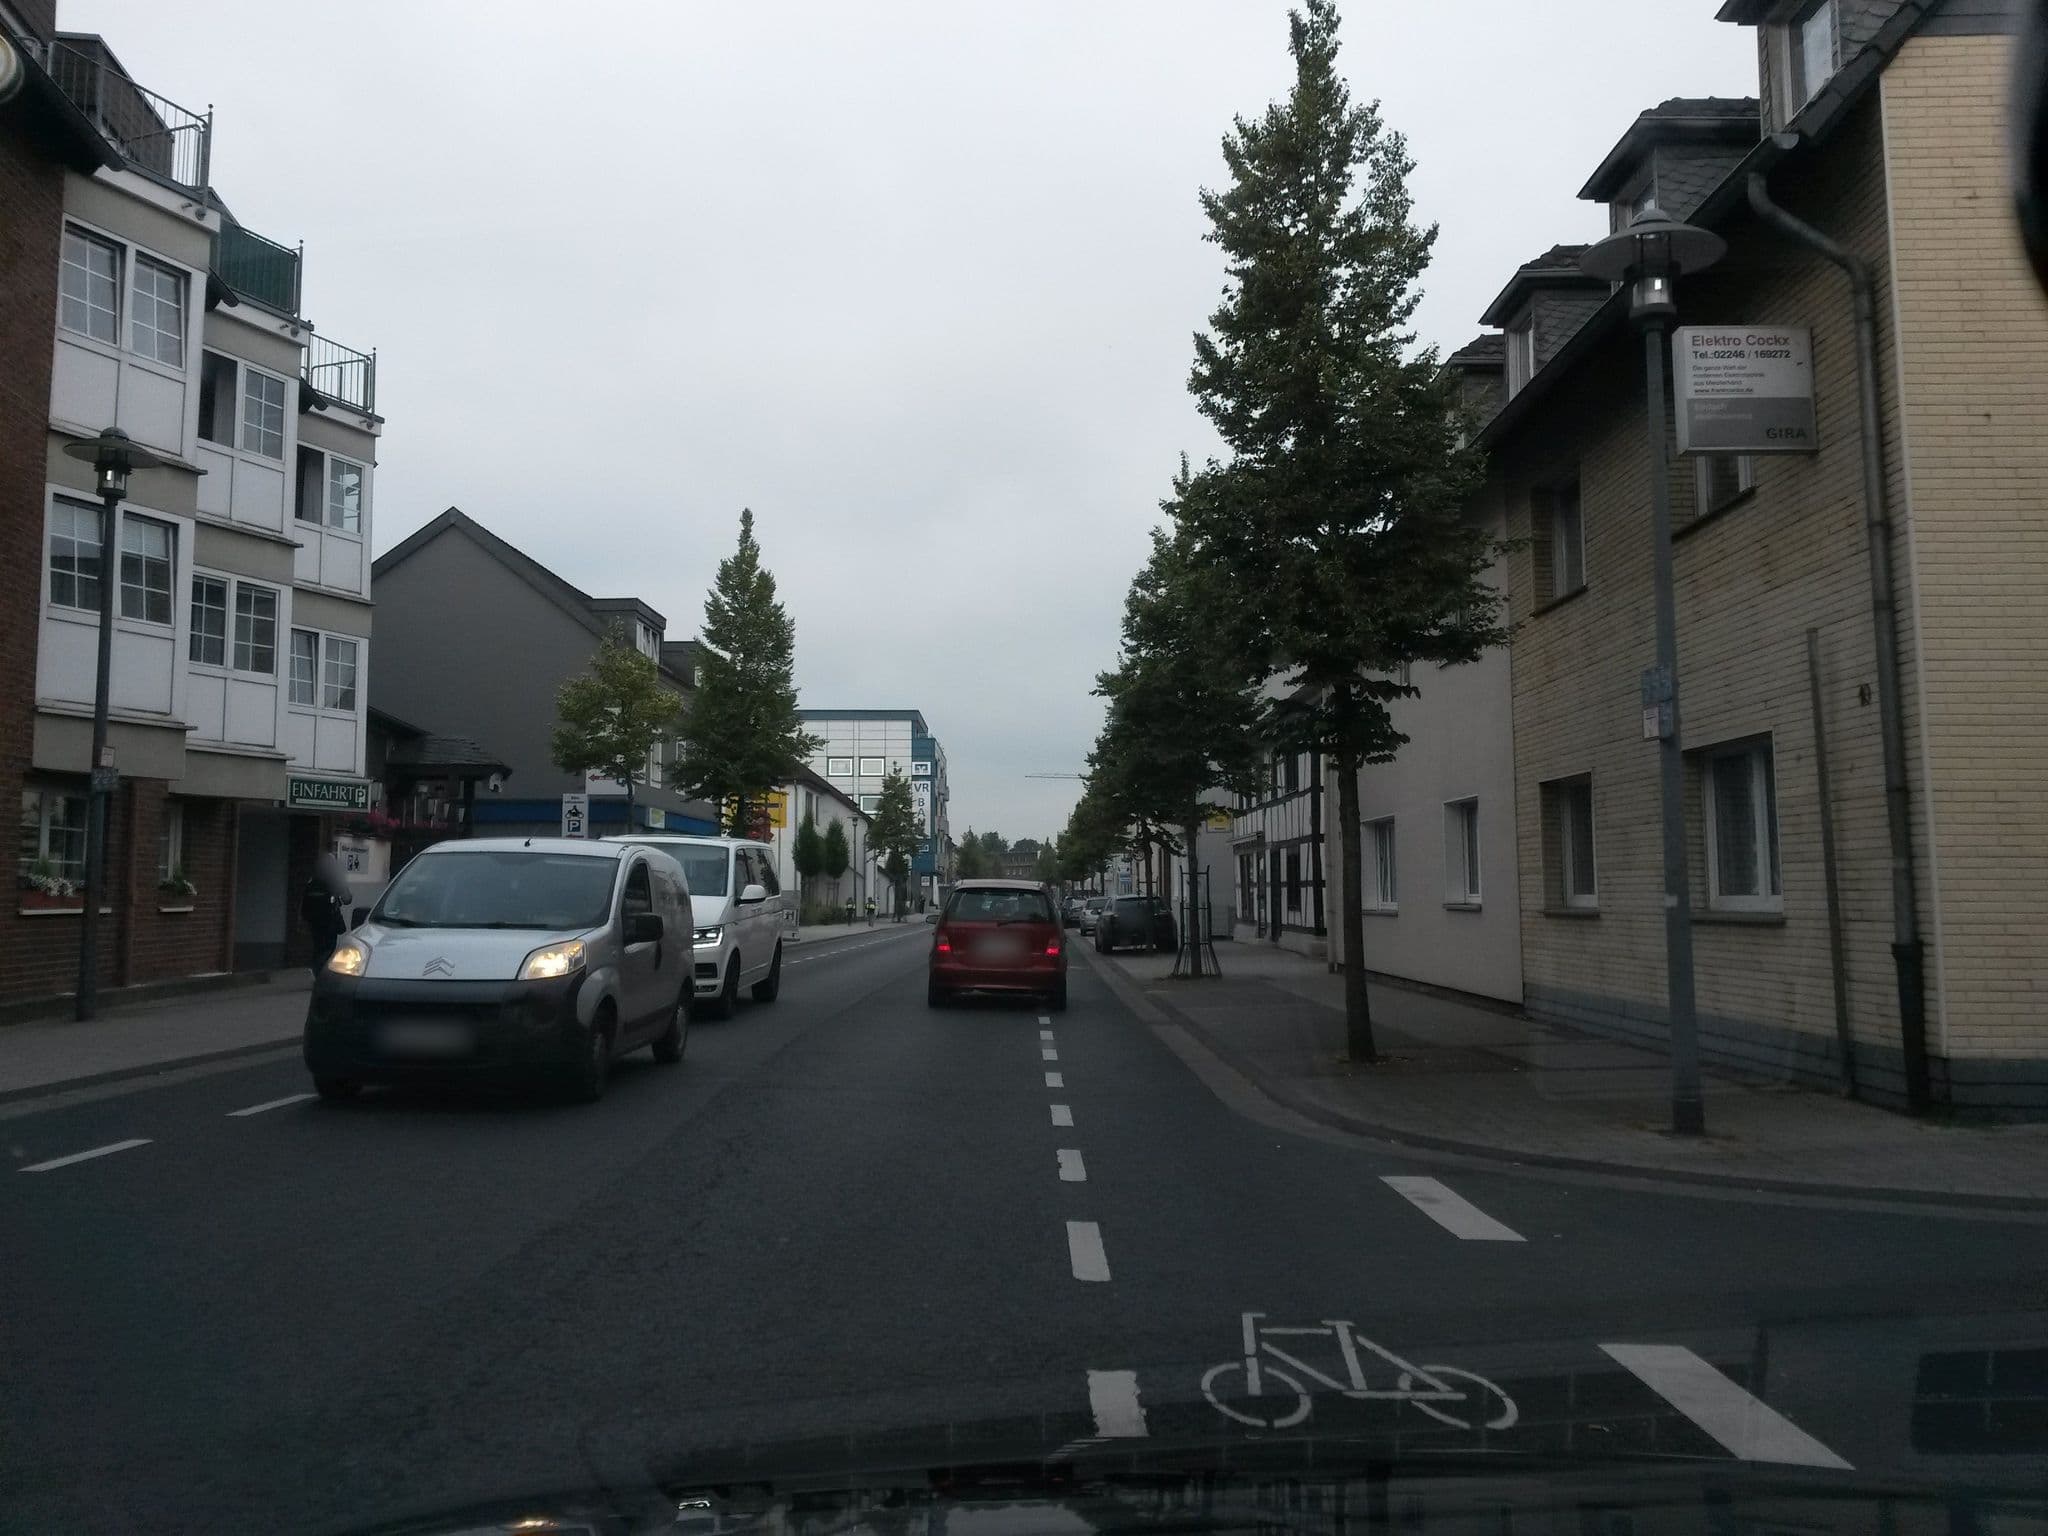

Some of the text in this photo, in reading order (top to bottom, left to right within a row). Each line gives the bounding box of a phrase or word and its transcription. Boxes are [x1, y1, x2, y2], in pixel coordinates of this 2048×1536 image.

[1692, 334, 1790, 347] Elektro Cockx
[1766, 427, 1808, 439] GIRA
[292, 782, 355, 801] EINFAHRT
[914, 783, 929, 793] VR
[917, 797, 926, 834] BAN
[569, 821, 580, 831] P
